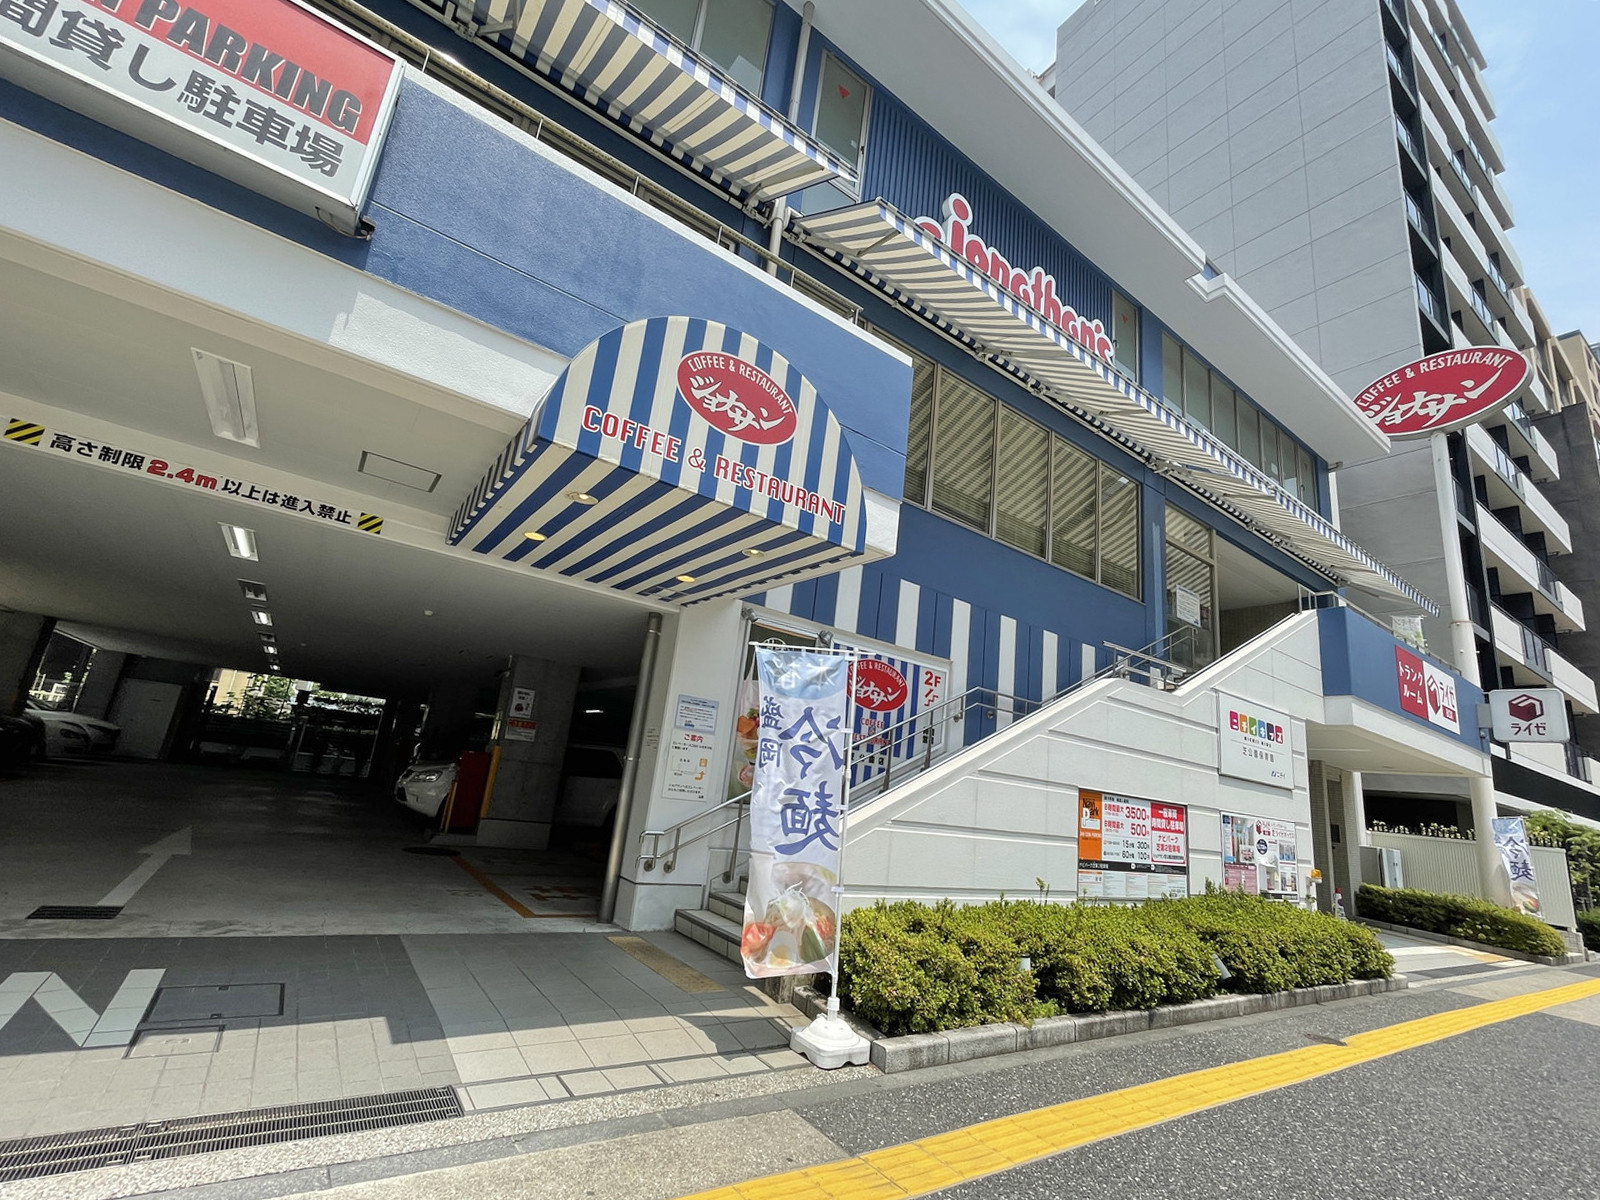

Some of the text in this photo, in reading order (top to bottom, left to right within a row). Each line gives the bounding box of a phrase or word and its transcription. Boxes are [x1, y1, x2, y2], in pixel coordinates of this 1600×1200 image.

[135, 0, 364, 135] PARKING
[687, 355, 794, 416] COFFEE & RESTAURANT
[1357, 351, 1514, 408] COFFEE & RESTAURANT
[688, 374, 786, 433] ジョナサン
[581, 404, 846, 525] COFFEE & RESTAURANT
[874, 662, 905, 687] RESTAURANT
[924, 670, 941, 688] 2F
[1398, 661, 1424, 686] トランク
[1403, 684, 1424, 706] ルーム
[1439, 681, 1456, 709] ライゼ
[861, 717, 884, 729] COFFEE
[1510, 722, 1547, 736] ライゼ
